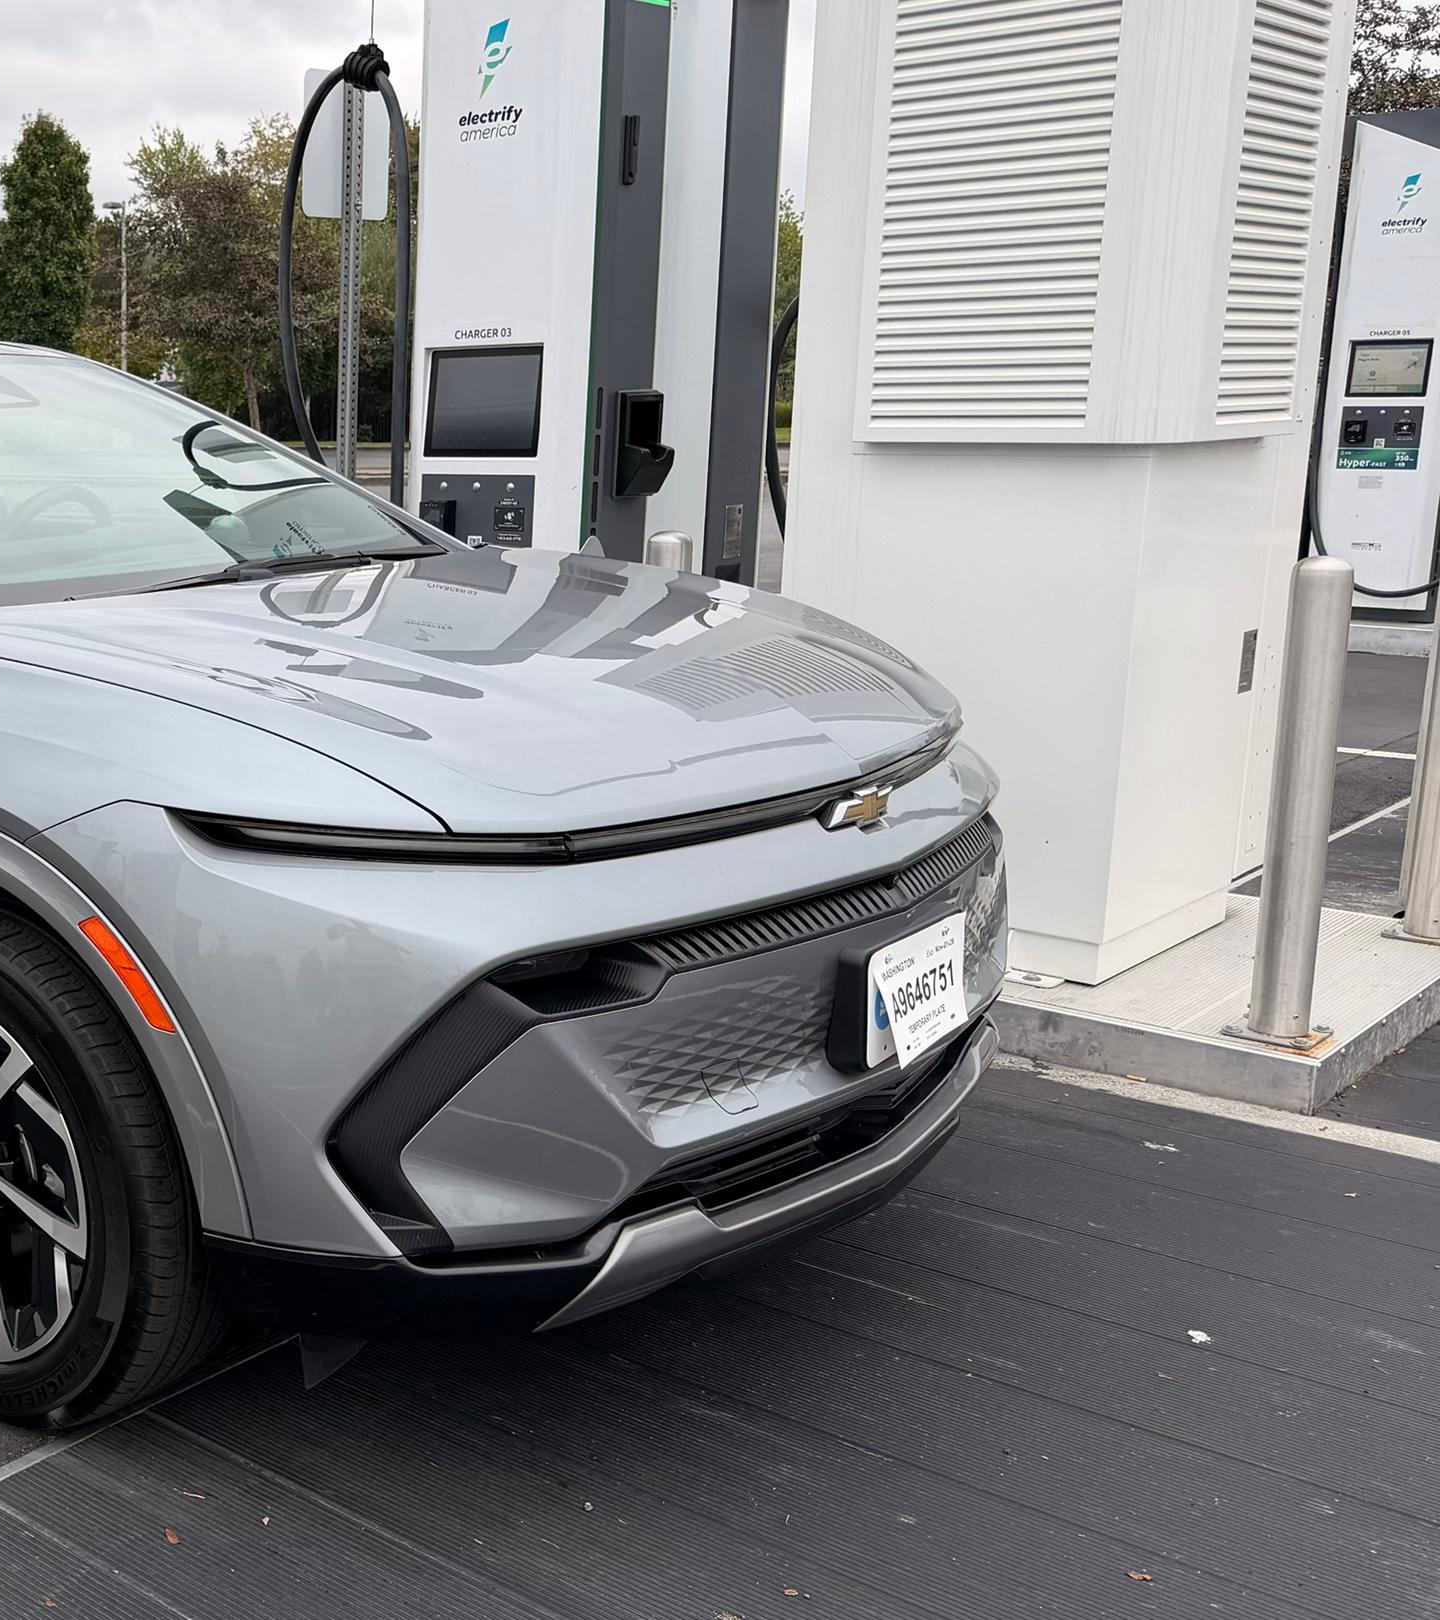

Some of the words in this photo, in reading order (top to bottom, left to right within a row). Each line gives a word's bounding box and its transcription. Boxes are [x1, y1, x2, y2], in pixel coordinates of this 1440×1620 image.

[458, 105, 523, 127] electrify
[459, 123, 517, 142] america
[1381, 217, 1428, 227] electrify
[1381, 226, 1423, 236] america
[454, 328, 499, 340] CHARGER
[500, 327, 512, 338] 03
[880, 956, 916, 982] WASHINGTON
[891, 958, 954, 1023] A9646751
[931, 1003, 946, 1020] PLATE
